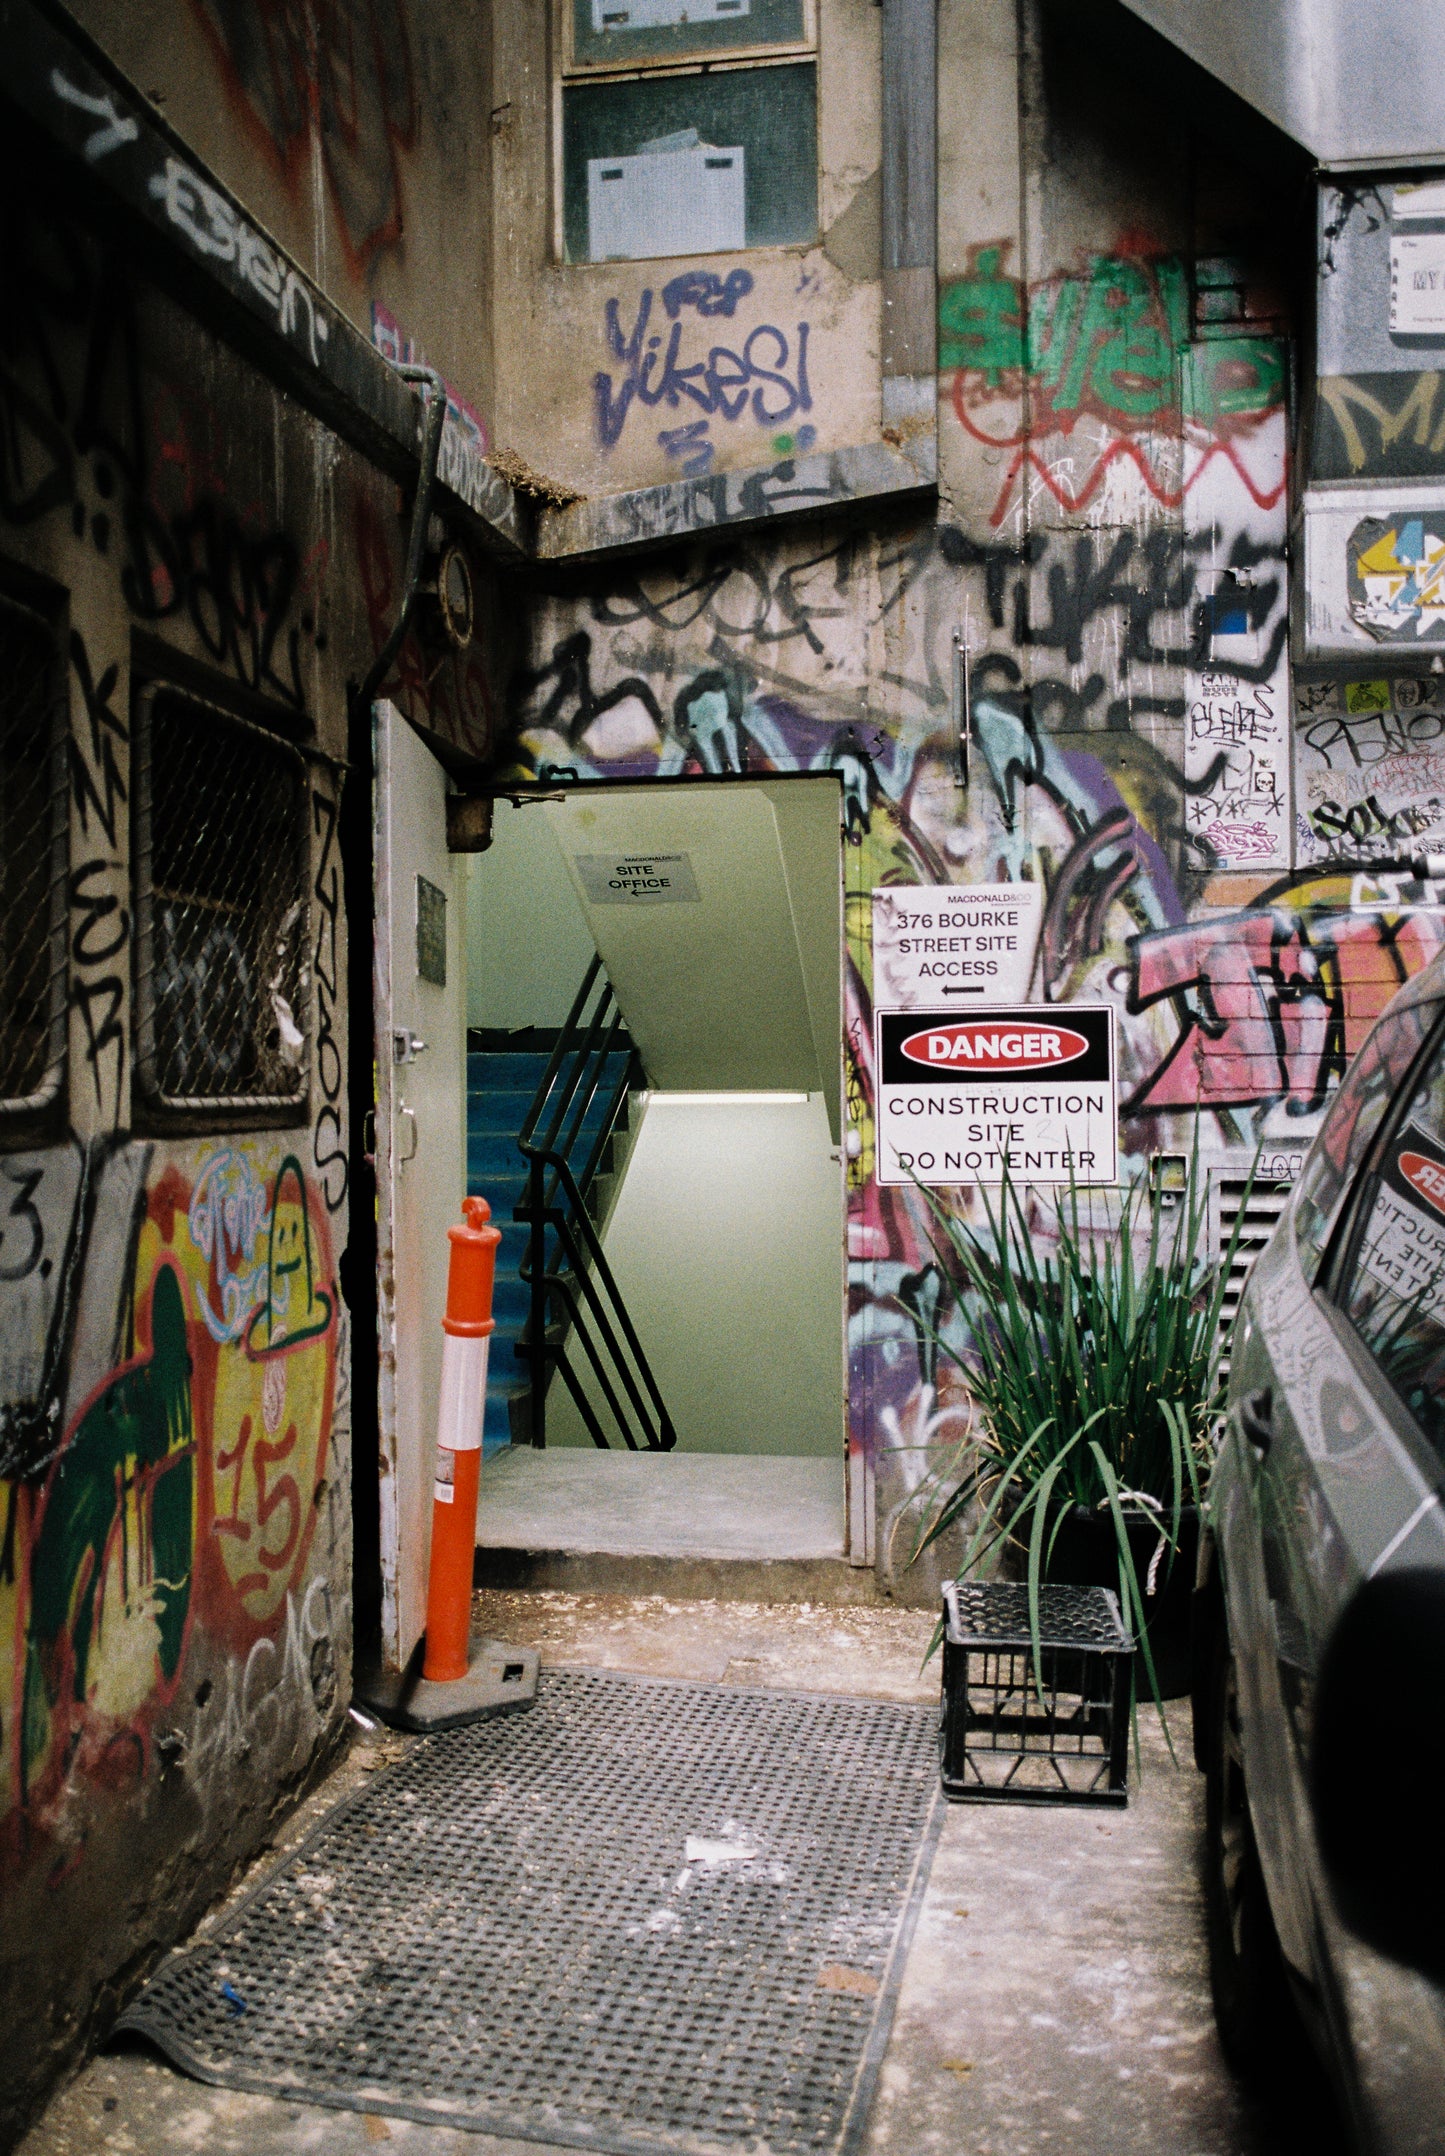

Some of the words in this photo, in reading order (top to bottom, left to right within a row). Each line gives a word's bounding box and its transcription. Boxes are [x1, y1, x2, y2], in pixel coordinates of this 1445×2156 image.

[616, 865, 654, 876] SITE
[608, 878, 671, 889] OFFICE
[897, 913, 934, 929] 376
[938, 911, 1019, 928] BOURKE
[899, 936, 972, 953] STREET
[975, 935, 1018, 951] SITE
[918, 960, 999, 977] ACCESS
[927, 1033, 1063, 1060] DANGER
[888, 1096, 1104, 1116] CONSTRUCTION
[967, 1123, 1025, 1142] SITE
[898, 1151, 935, 1170] DO
[944, 1151, 1002, 1169] NOT
[1006, 1150, 1096, 1169] ENTER
